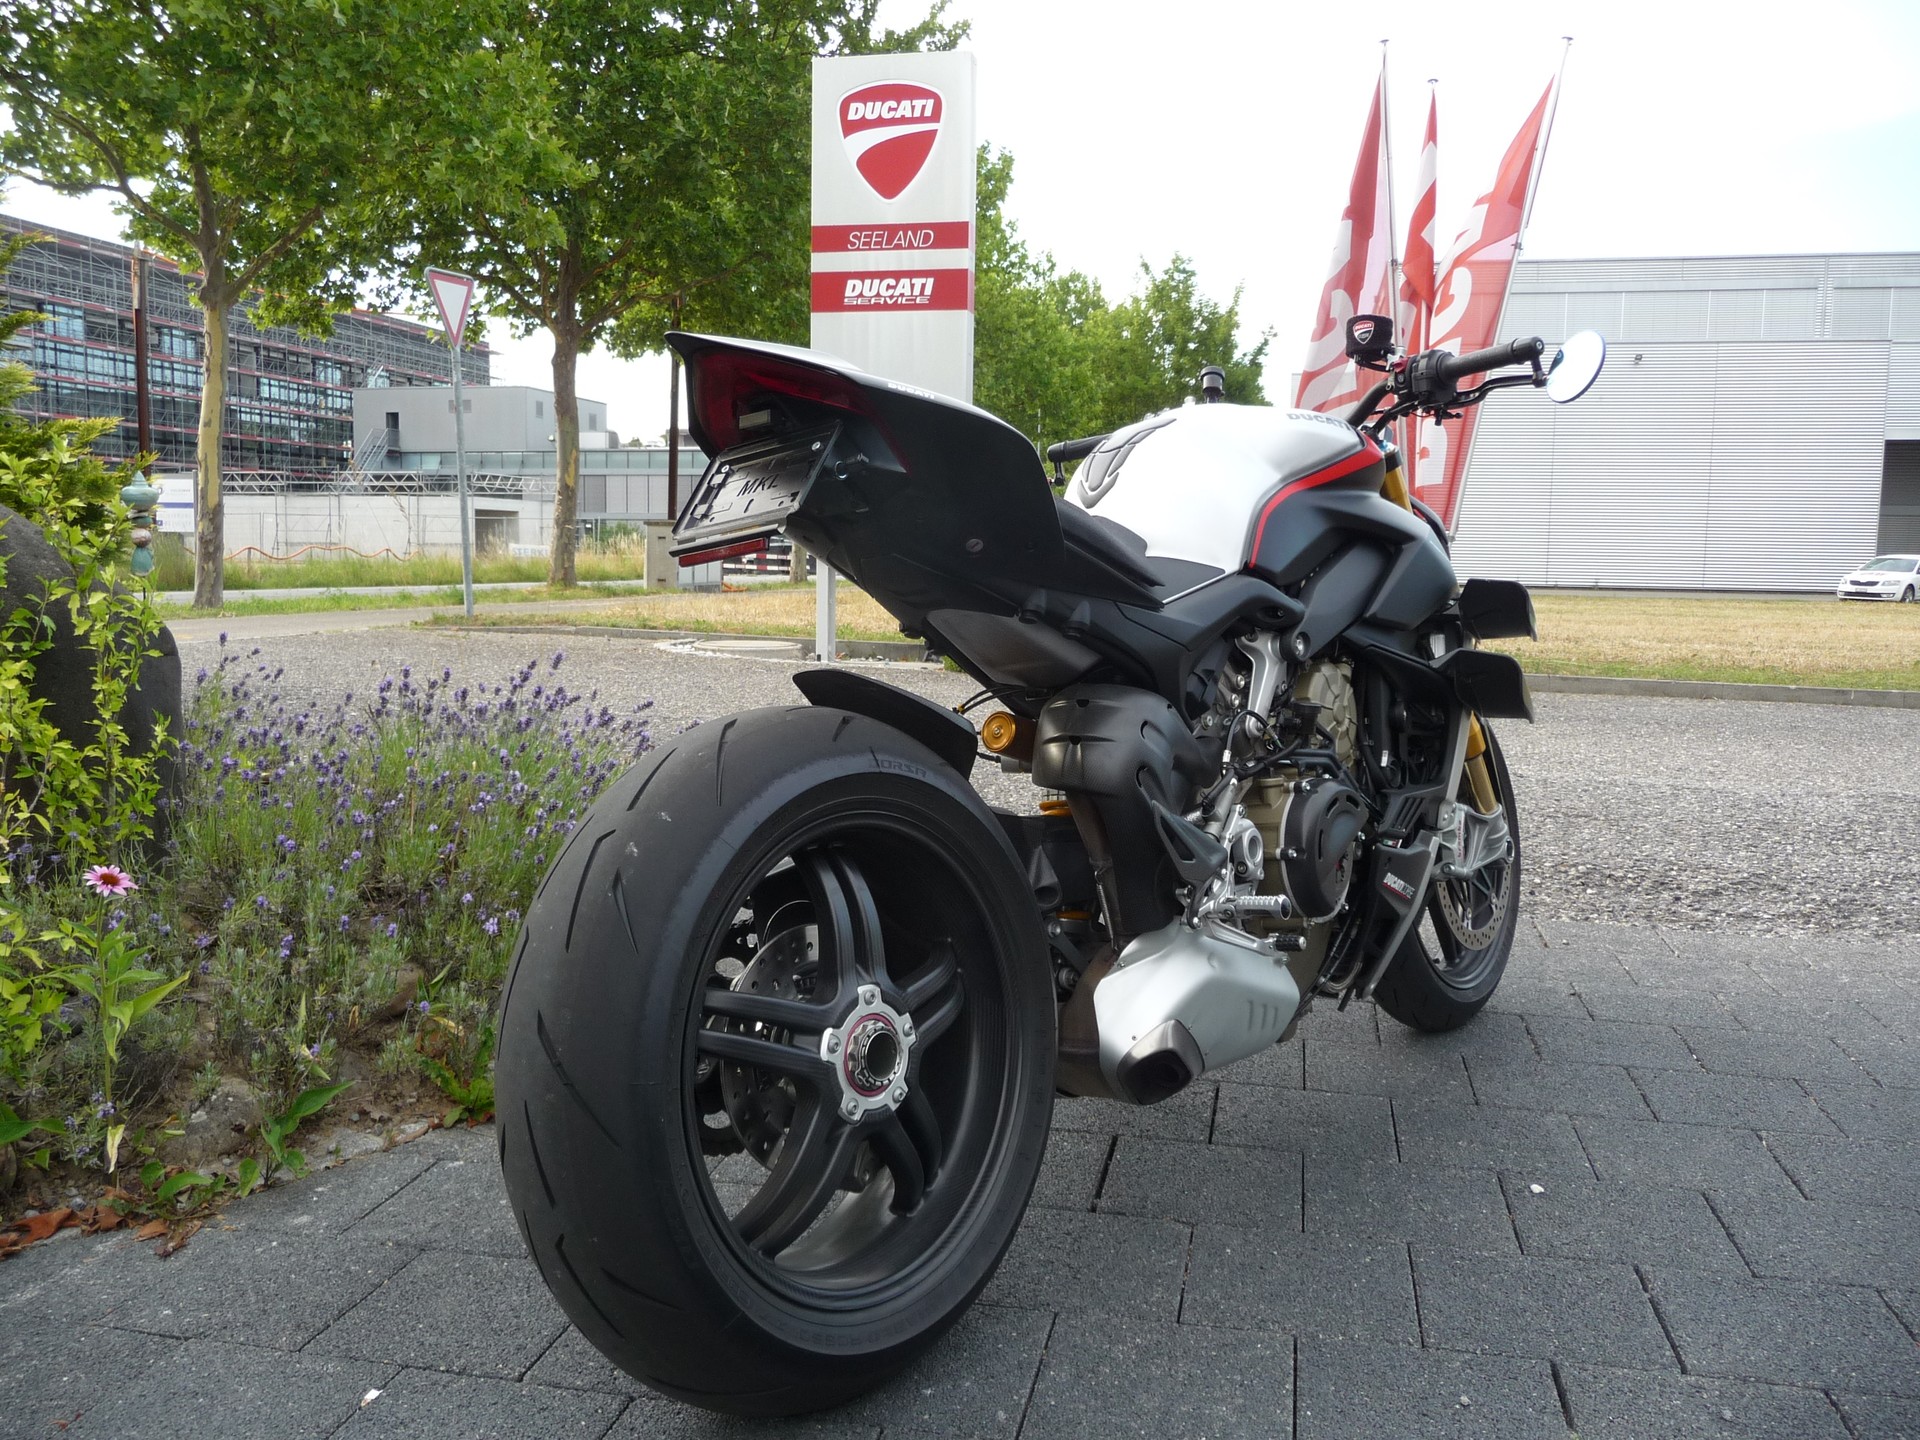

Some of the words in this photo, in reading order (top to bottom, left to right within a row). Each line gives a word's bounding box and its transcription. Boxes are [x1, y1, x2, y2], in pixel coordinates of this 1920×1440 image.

[847, 98, 935, 121] DUCATI
[847, 229, 935, 250] SEELAND
[844, 277, 935, 297] DUCATI
[843, 296, 931, 305] SERVICE
[887, 382, 935, 400] DUCATI
[1286, 413, 1351, 432] DUCATI
